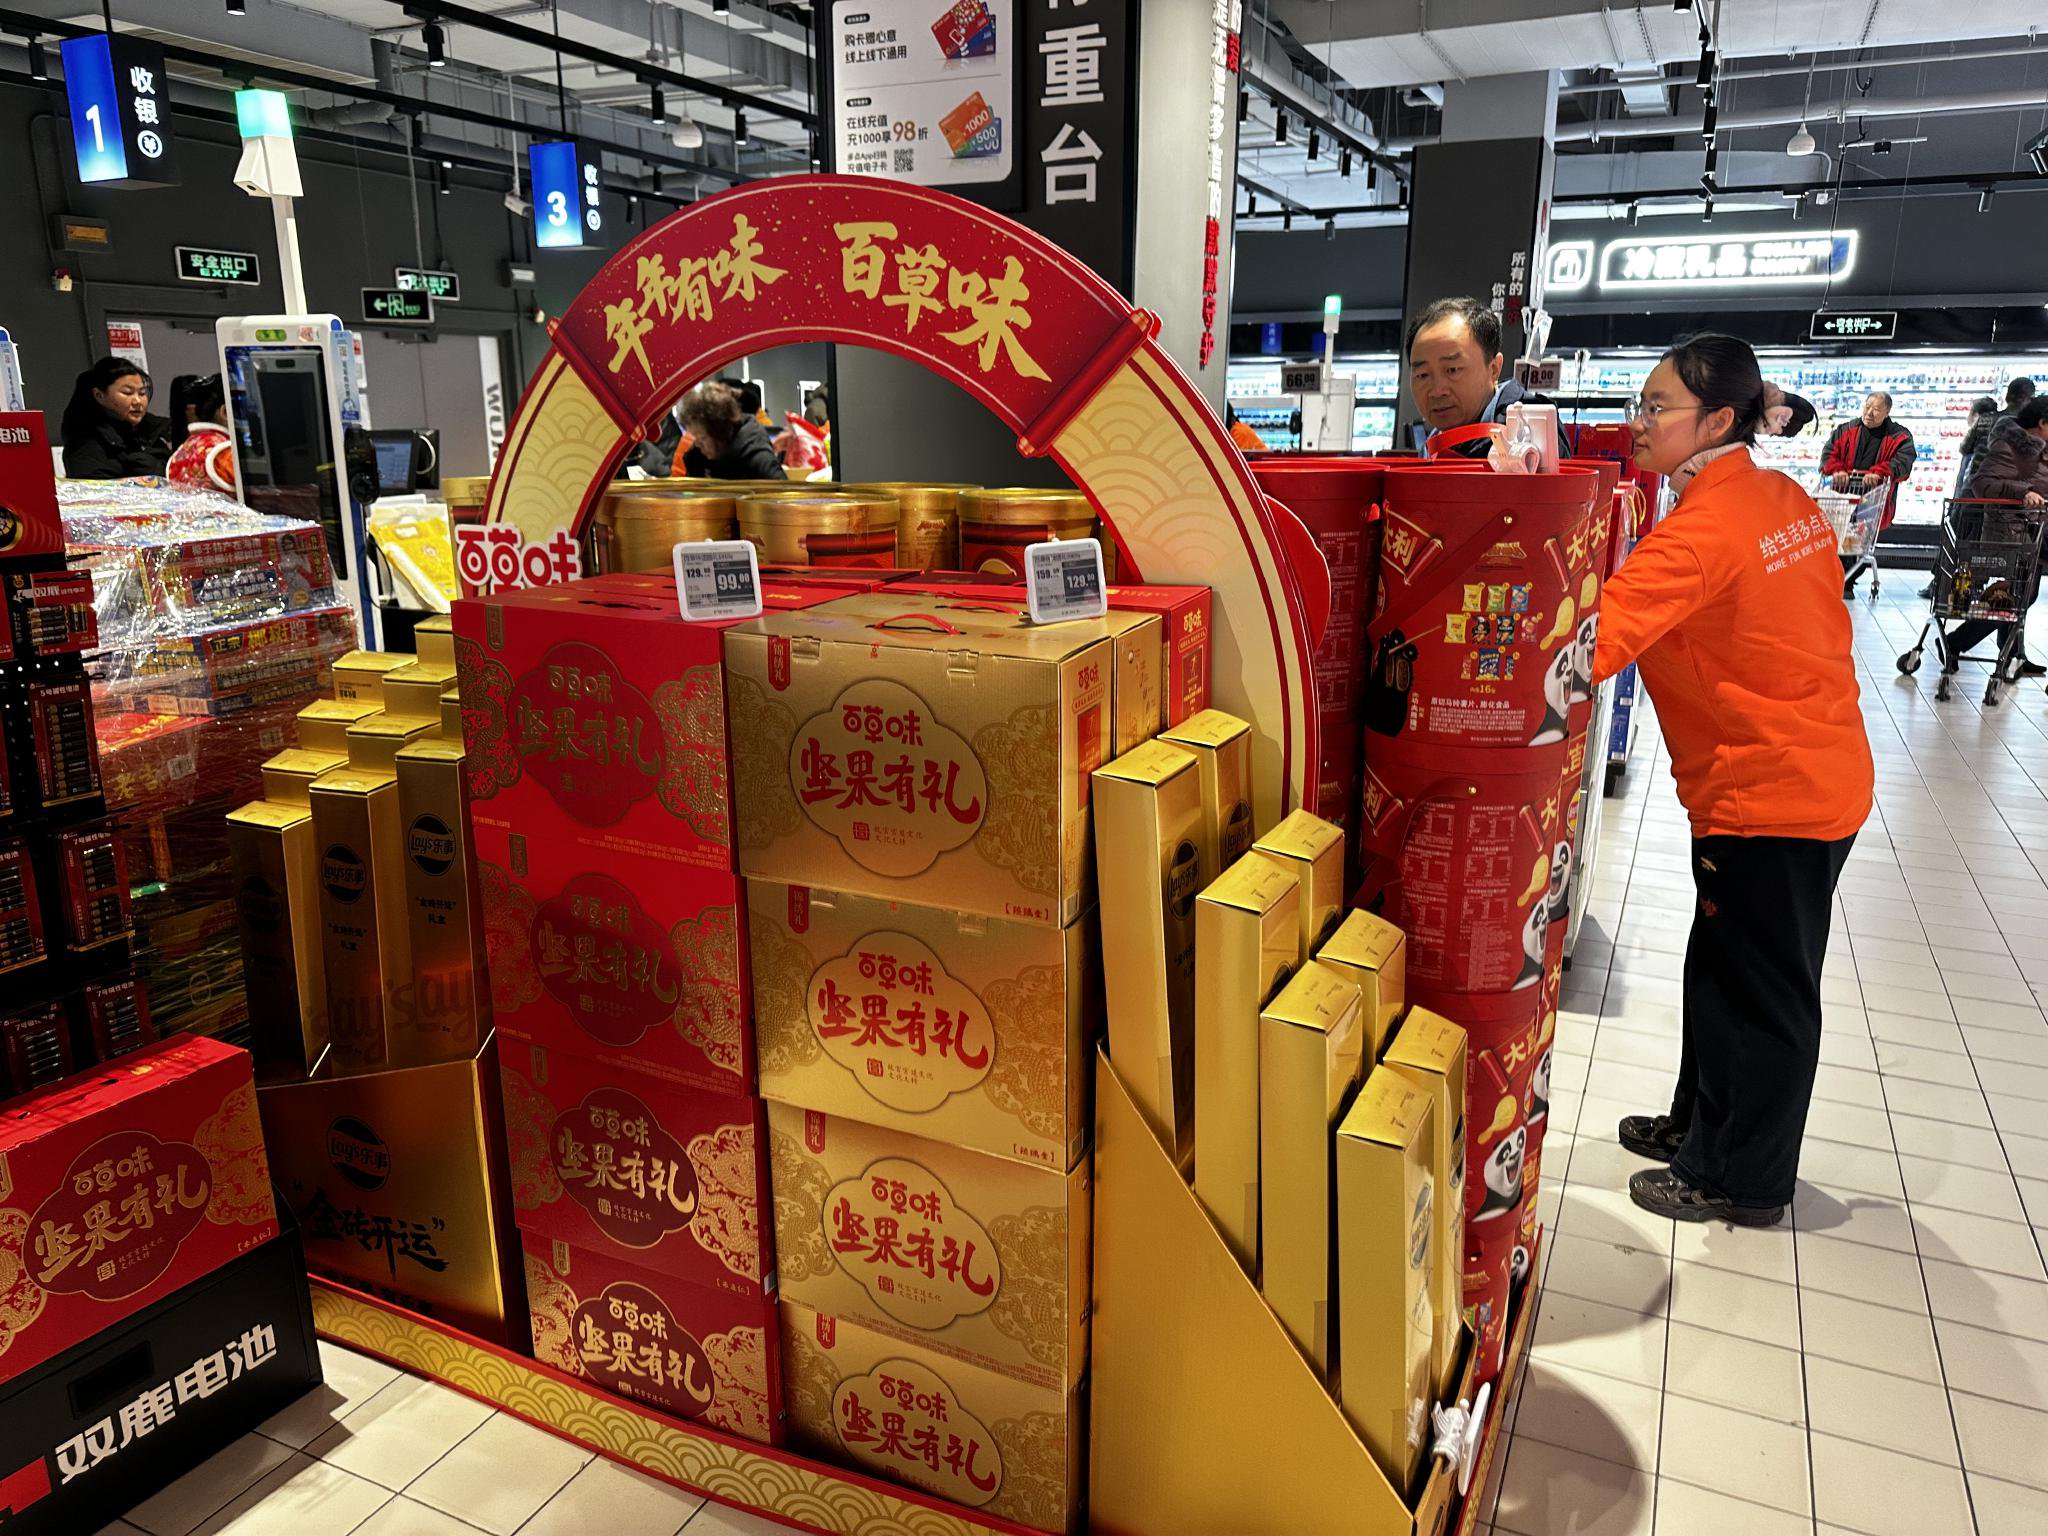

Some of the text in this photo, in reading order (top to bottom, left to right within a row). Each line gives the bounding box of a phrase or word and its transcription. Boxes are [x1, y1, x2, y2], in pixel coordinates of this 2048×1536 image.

[845, 45, 907, 64] 线上线下通用
[130, 66, 160, 125] 收银
[1039, 0, 1107, 205] 重台
[86, 104, 105, 153] 1
[846, 114, 888, 130] 在线充值
[547, 190, 568, 227] 3
[190, 253, 247, 272] 安全出口
[200, 267, 240, 279] EXIT
[605, 212, 788, 390] 年年有味
[833, 221, 1053, 384] 百草味
[457, 526, 579, 595] 百草味
[717, 573, 750, 591] 99.00
[1765, 556, 1788, 574] MORE
[1788, 551, 1802, 565] FUN
[213, 635, 241, 652] 正宗
[550, 665, 613, 704] 百草味
[1077, 662, 1100, 690] 百草味
[515, 695, 661, 776] 坚果有礼
[843, 704, 924, 747] 百草味
[800, 737, 981, 825] 坚果有礼
[539, 920, 679, 1004] 坚果有礼
[858, 952, 935, 996] 百草味
[816, 979, 989, 1070] 坚果有礼
[590, 1105, 651, 1147] 百草味
[73, 1146, 154, 1196] 百草味
[558, 1127, 695, 1213] 坚果有礼
[35, 1164, 209, 1283] 坚果有礼
[871, 1176, 943, 1225] 百草味
[831, 1197, 994, 1297] 坚果有礼
[608, 1297, 669, 1340] 百草味
[578, 1314, 711, 1403] 坚果有礼
[55, 1324, 277, 1485] 双鹿电池
[879, 1374, 949, 1423] 百草味
[840, 1391, 996, 1492] 坚果有礼
